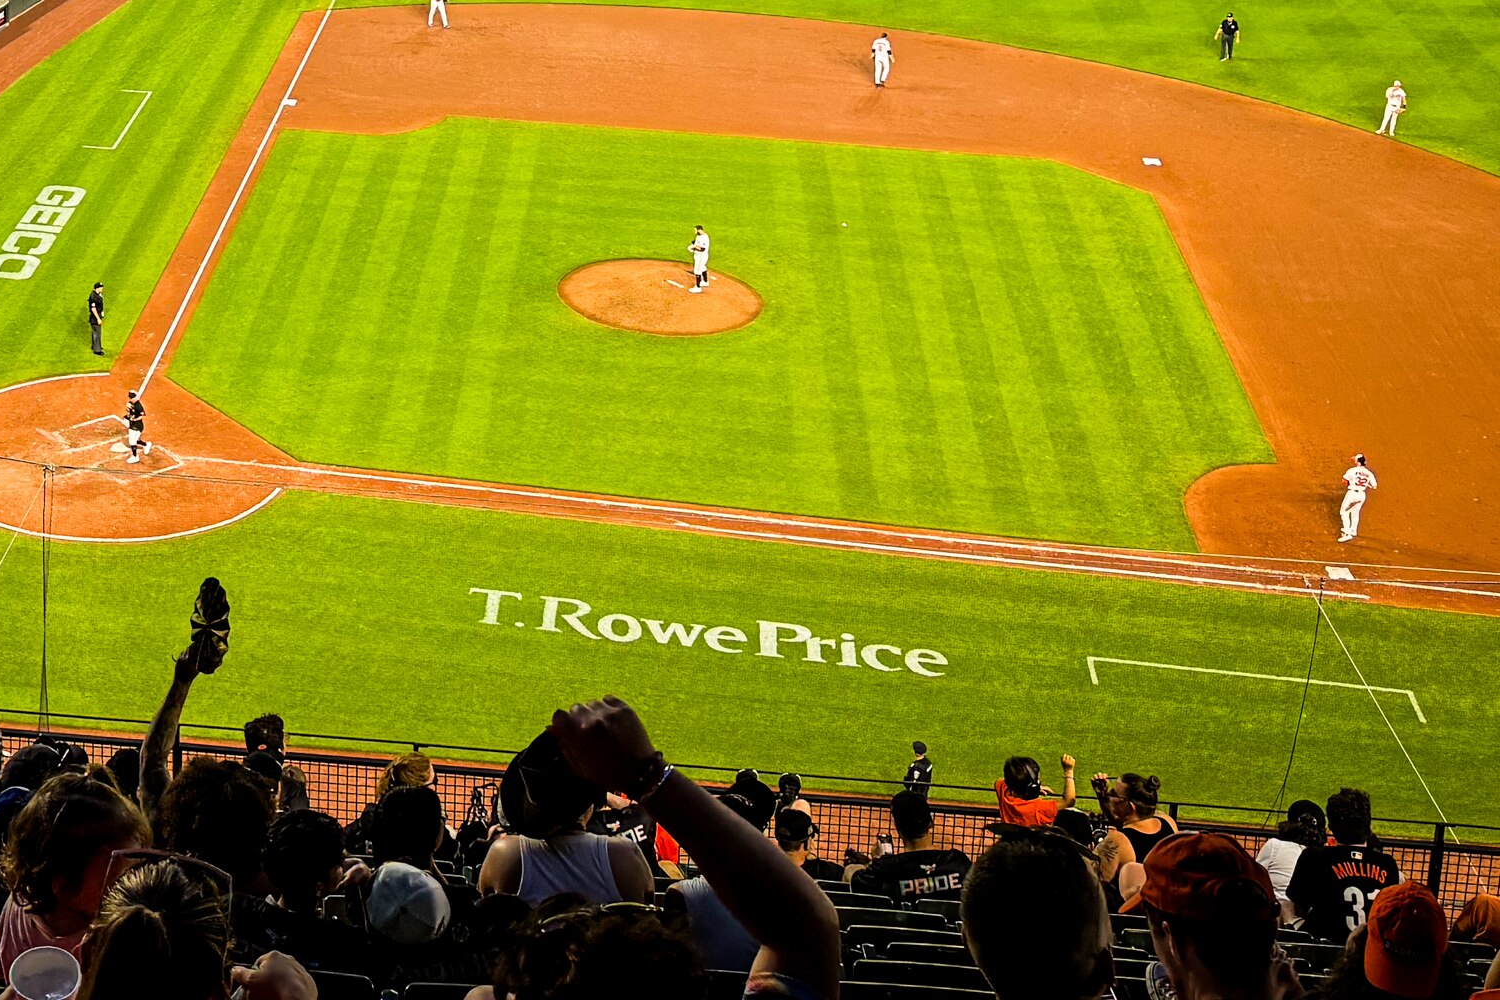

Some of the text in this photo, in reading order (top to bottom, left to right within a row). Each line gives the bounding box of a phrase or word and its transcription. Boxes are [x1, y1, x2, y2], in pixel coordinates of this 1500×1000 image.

[1355, 477, 1368, 487] 32
[899, 872, 962, 897] PRIDE
[1332, 861, 1387, 884] MULLINS
[1343, 886, 1381, 932] 3
